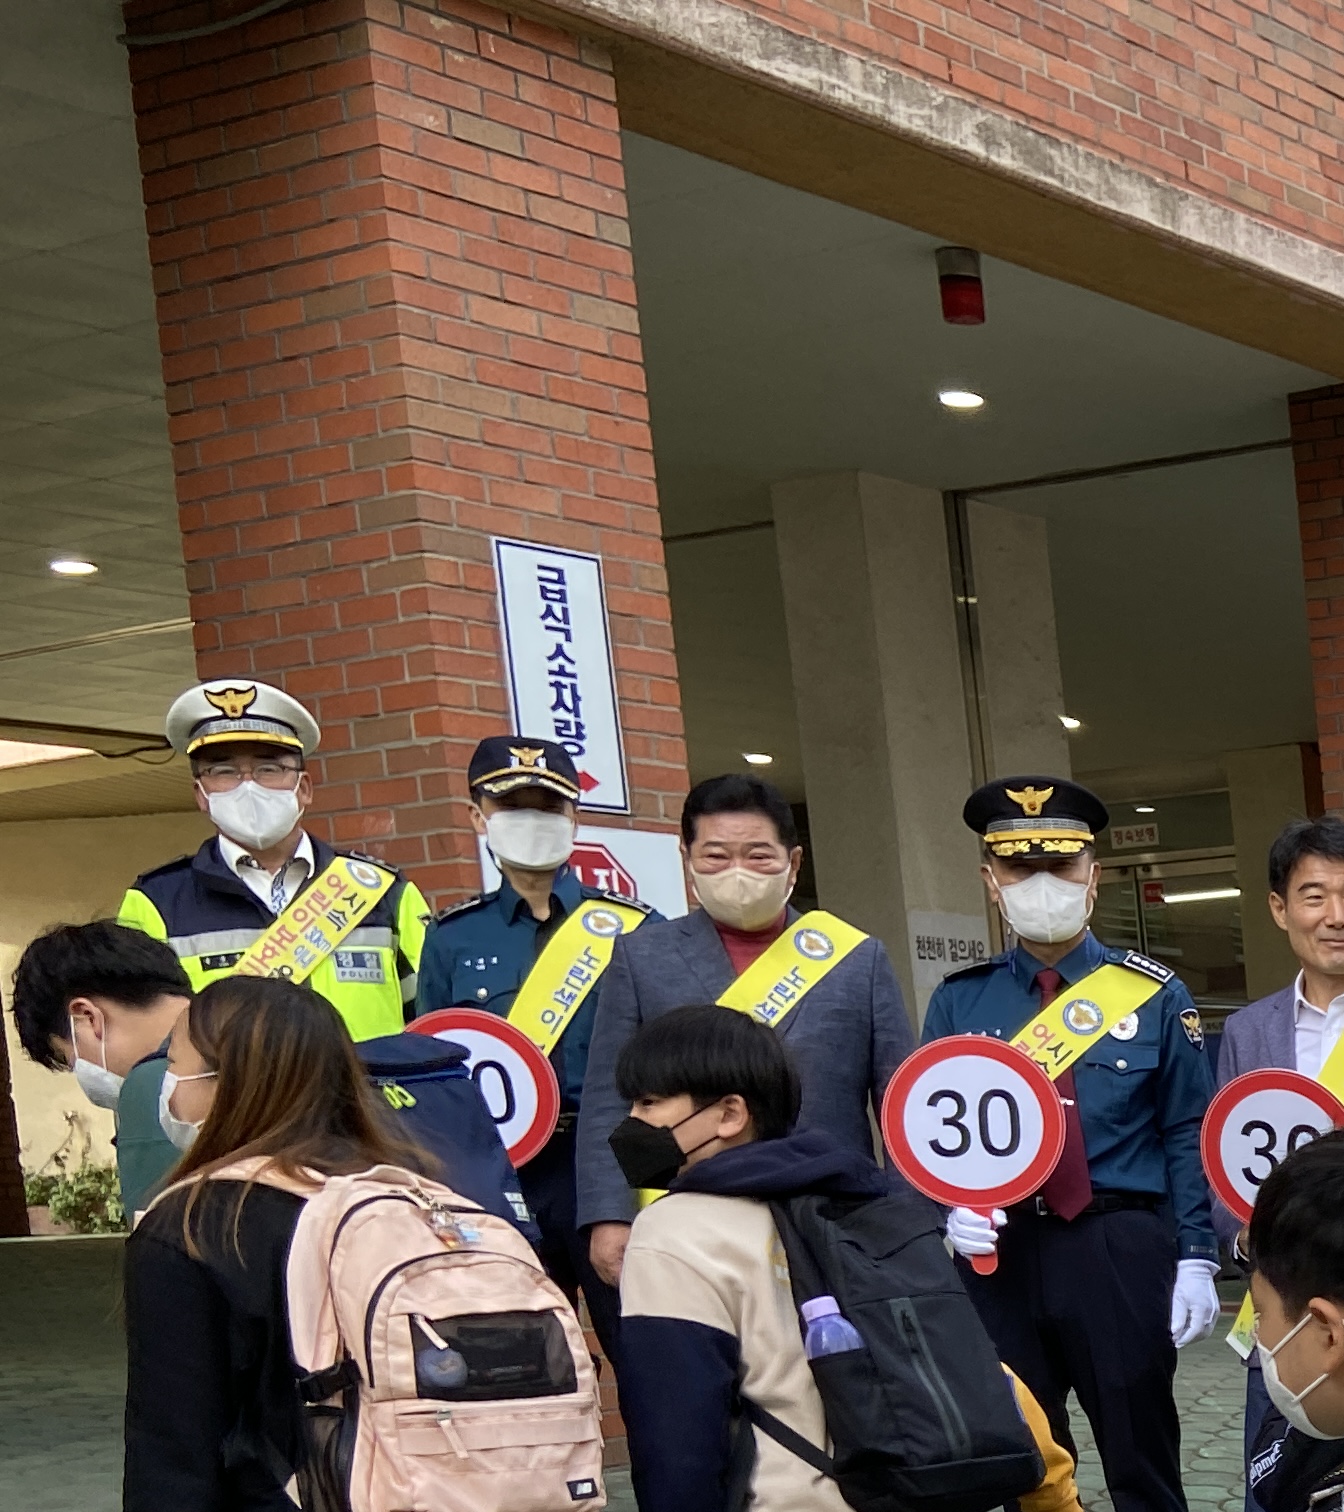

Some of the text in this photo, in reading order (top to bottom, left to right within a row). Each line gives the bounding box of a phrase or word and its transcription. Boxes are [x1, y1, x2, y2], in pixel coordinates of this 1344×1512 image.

[536, 564, 588, 757] 급식소차량
[326, 892, 367, 932] 시속
[916, 935, 947, 961] 천천히
[341, 971, 381, 979] POLICE
[926, 1088, 1021, 1158] 30
